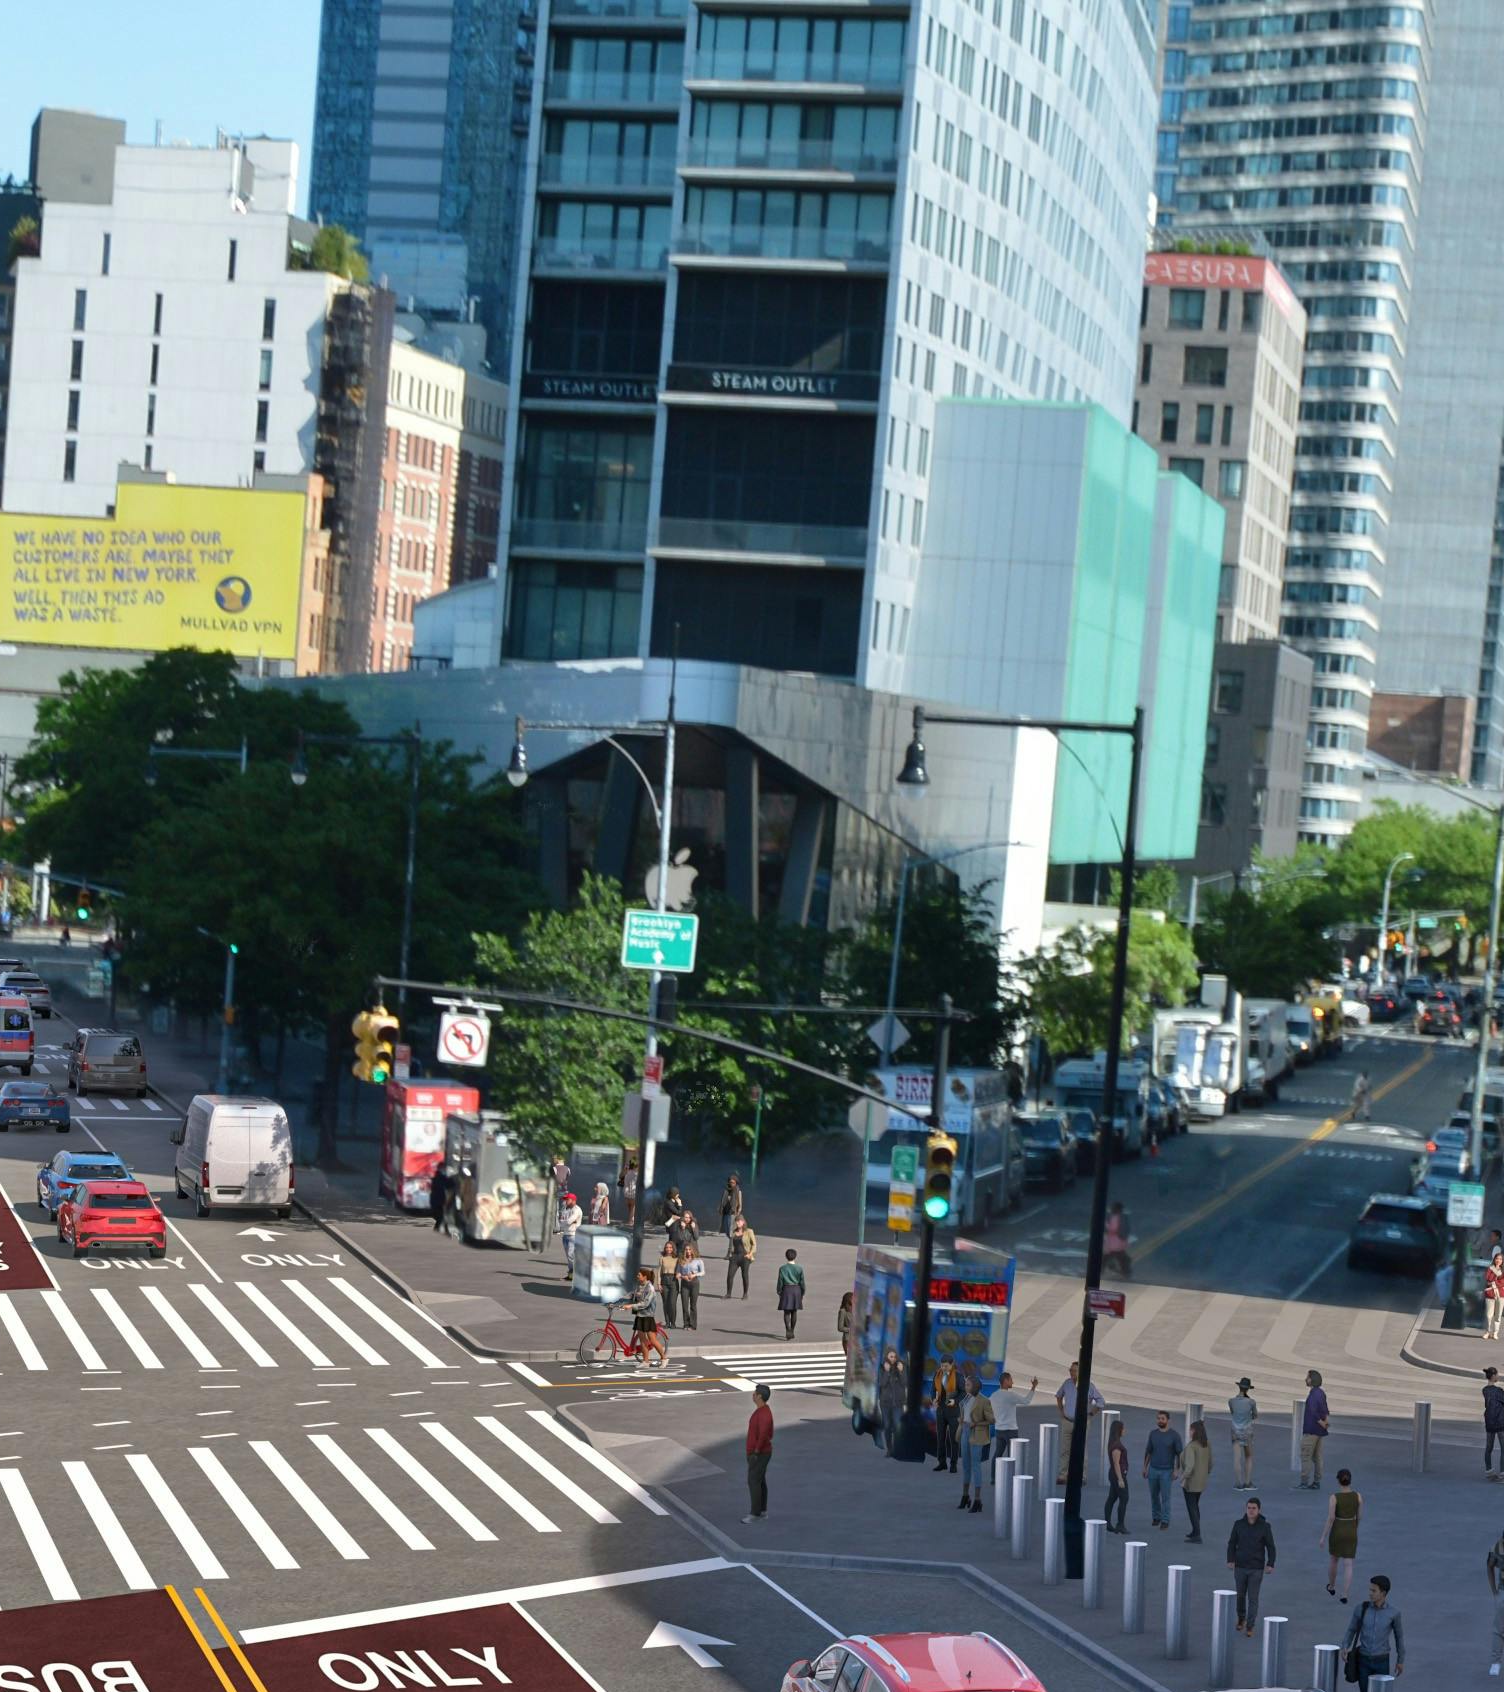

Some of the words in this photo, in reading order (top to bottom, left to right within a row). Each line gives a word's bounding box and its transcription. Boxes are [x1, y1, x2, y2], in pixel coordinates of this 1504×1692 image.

[1143, 258, 1251, 284] CAESURA
[543, 379, 593, 394] STEAM
[712, 371, 767, 390] STEAM
[772, 376, 839, 393] OUTLET
[14, 531, 35, 545] WE
[42, 531, 76, 545] HAVE
[82, 531, 104, 545] NO
[111, 531, 146, 545] IDEA
[153, 531, 185, 545] WHO
[191, 531, 220, 545] OUR
[14, 550, 99, 564] CUSTOMERS
[143, 550, 192, 564] MAYBE
[200, 550, 234, 564] THEY
[14, 569, 39, 583] ALL
[46, 569, 80, 582] LIVE
[86, 569, 105, 582] IN
[113, 568, 149, 582] NEW
[61, 590, 97, 605] THEN
[104, 590, 138, 605] THIS
[144, 590, 165, 605] AD
[14, 608, 47, 623] WAS
[54, 609, 63, 621] A
[180, 616, 248, 633] MULLVAD
[253, 620, 282, 633] VPN
[80, 1256, 186, 1270] ONLY
[241, 1253, 345, 1267] ONLY
[317, 1645, 513, 1692] ONLY
